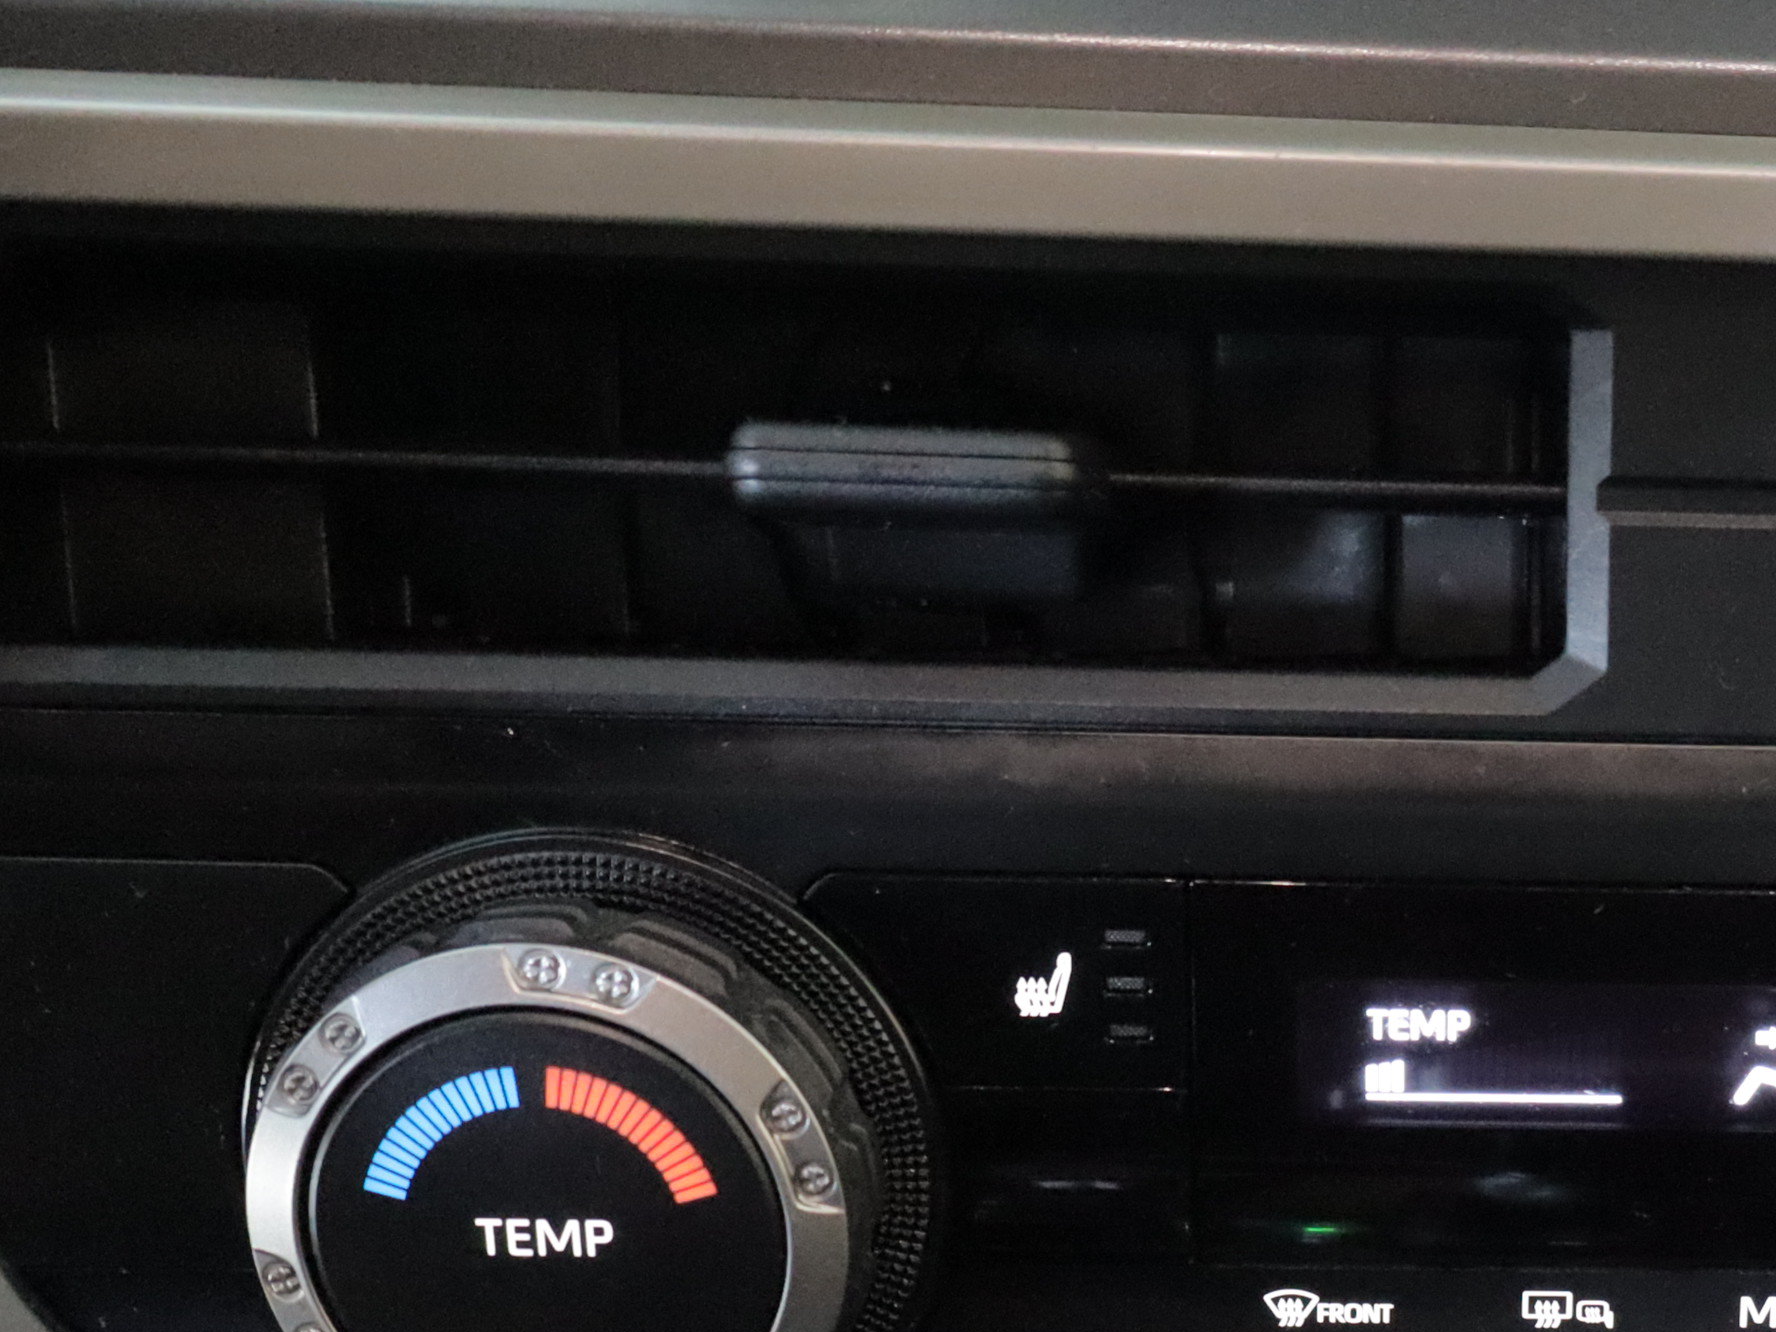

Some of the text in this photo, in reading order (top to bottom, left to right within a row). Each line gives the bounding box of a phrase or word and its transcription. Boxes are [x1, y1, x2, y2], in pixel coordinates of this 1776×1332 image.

[1366, 1006, 1472, 1043] TEMP
[474, 1217, 614, 1257] TEMP
[1316, 1302, 1394, 1324] FRONT
